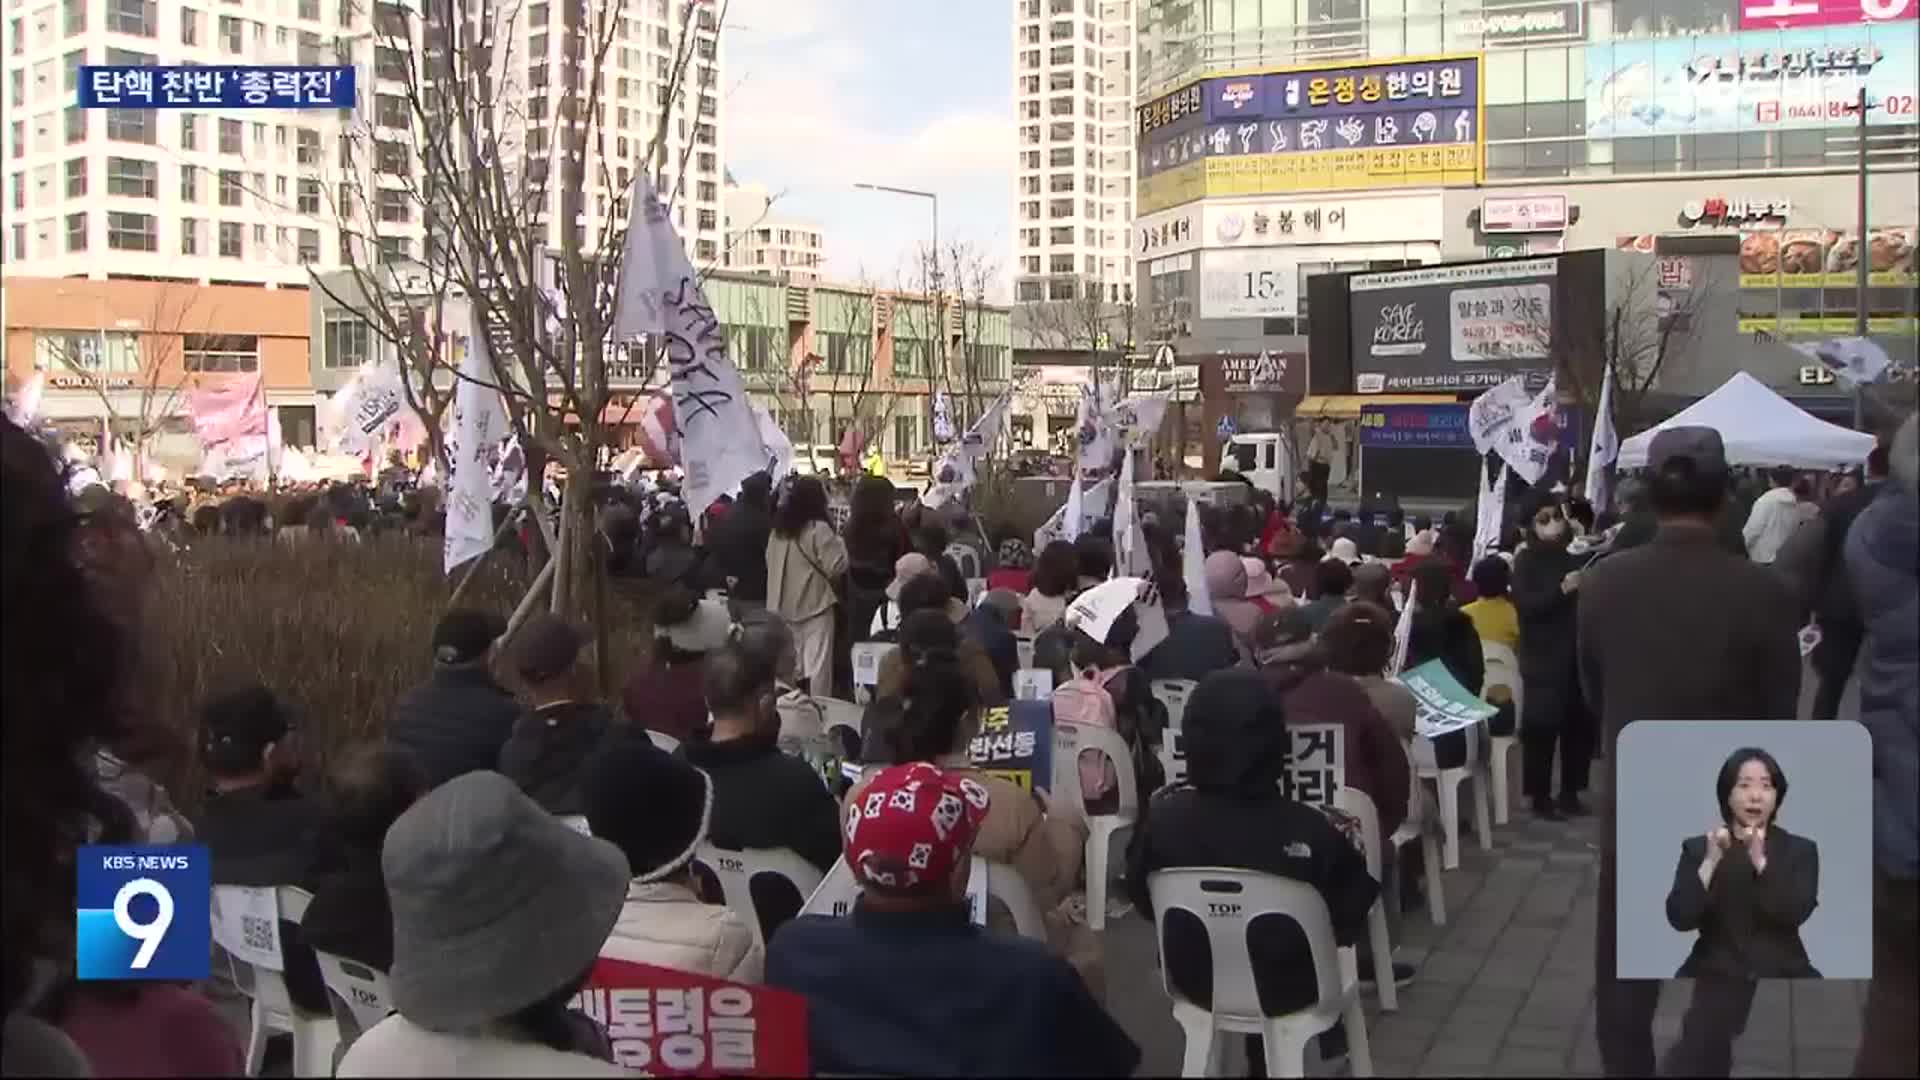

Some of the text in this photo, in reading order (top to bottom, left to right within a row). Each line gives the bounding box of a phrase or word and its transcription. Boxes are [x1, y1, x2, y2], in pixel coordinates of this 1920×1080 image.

[1307, 68, 1462, 107] 온정성한의원
[1244, 271, 1275, 299] 15
[1380, 302, 1416, 325] SAVE
[1457, 299, 1504, 319] 말씀과
[1374, 320, 1424, 343] KOREA
[1221, 359, 1288, 370] AMERAN
[1225, 370, 1246, 381] PIE
[964, 731, 1036, 763] 란선동
[718, 857, 743, 871] TOP
[1208, 903, 1242, 914] TOP
[350, 987, 379, 1004] TOP
